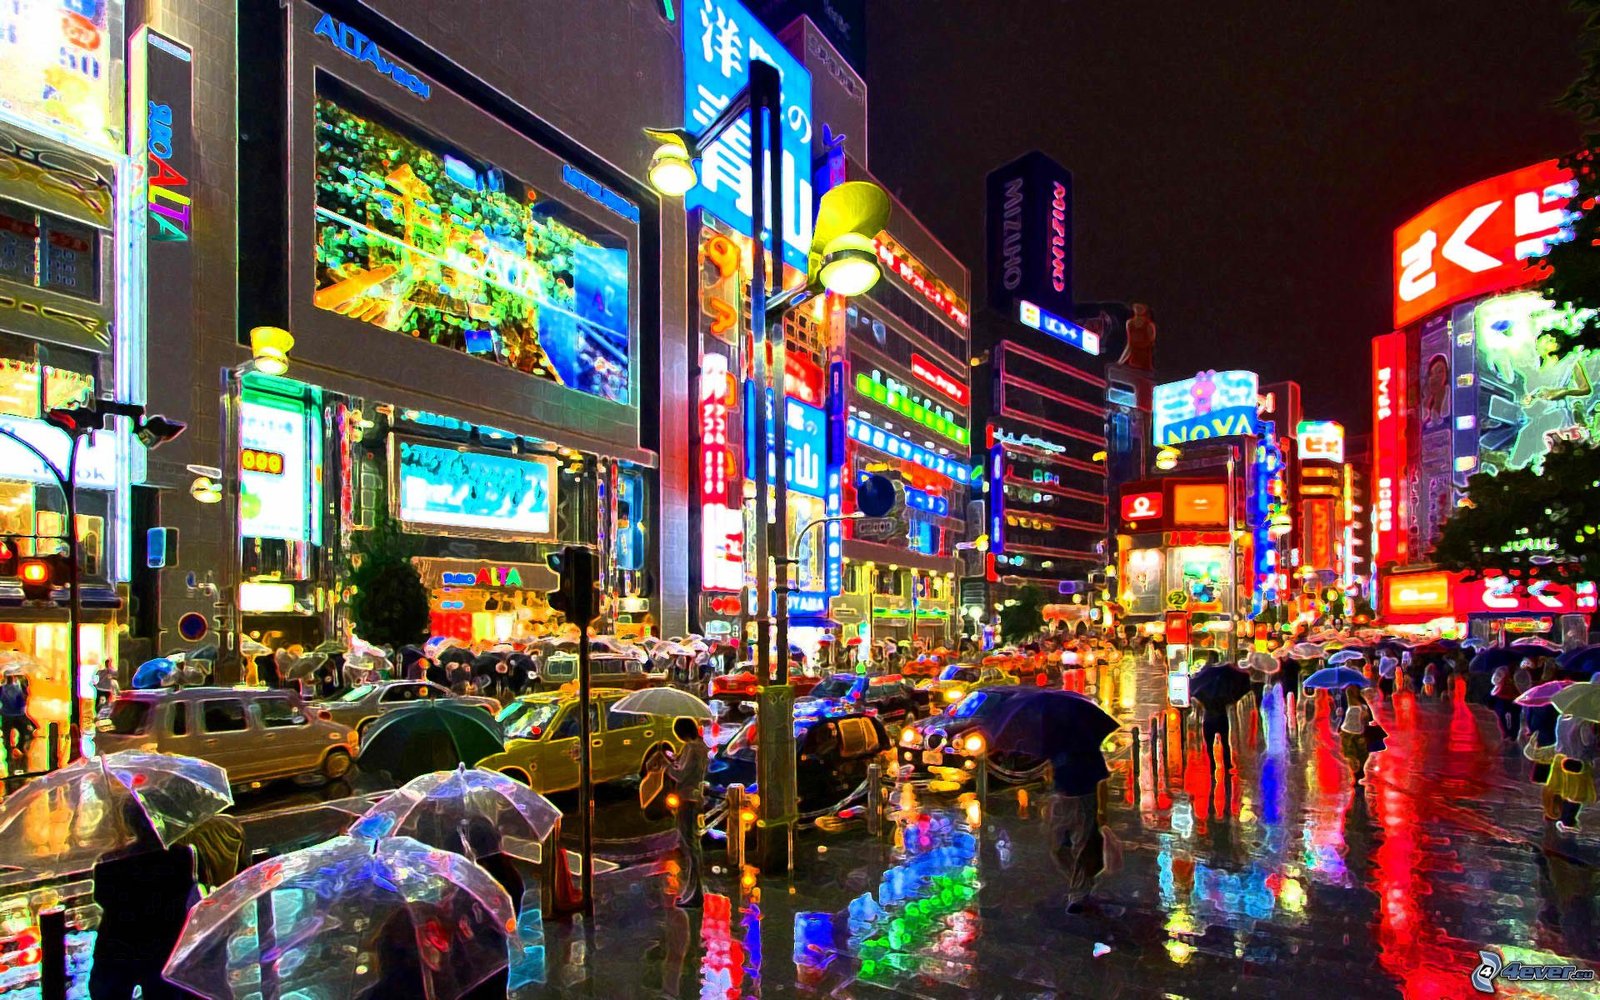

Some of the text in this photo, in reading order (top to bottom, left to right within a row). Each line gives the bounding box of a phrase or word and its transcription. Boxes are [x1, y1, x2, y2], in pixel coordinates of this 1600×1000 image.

[148, 152, 191, 242] ALTA
[1168, 412, 1253, 443] NOVA
[476, 566, 523, 587] ALTA
